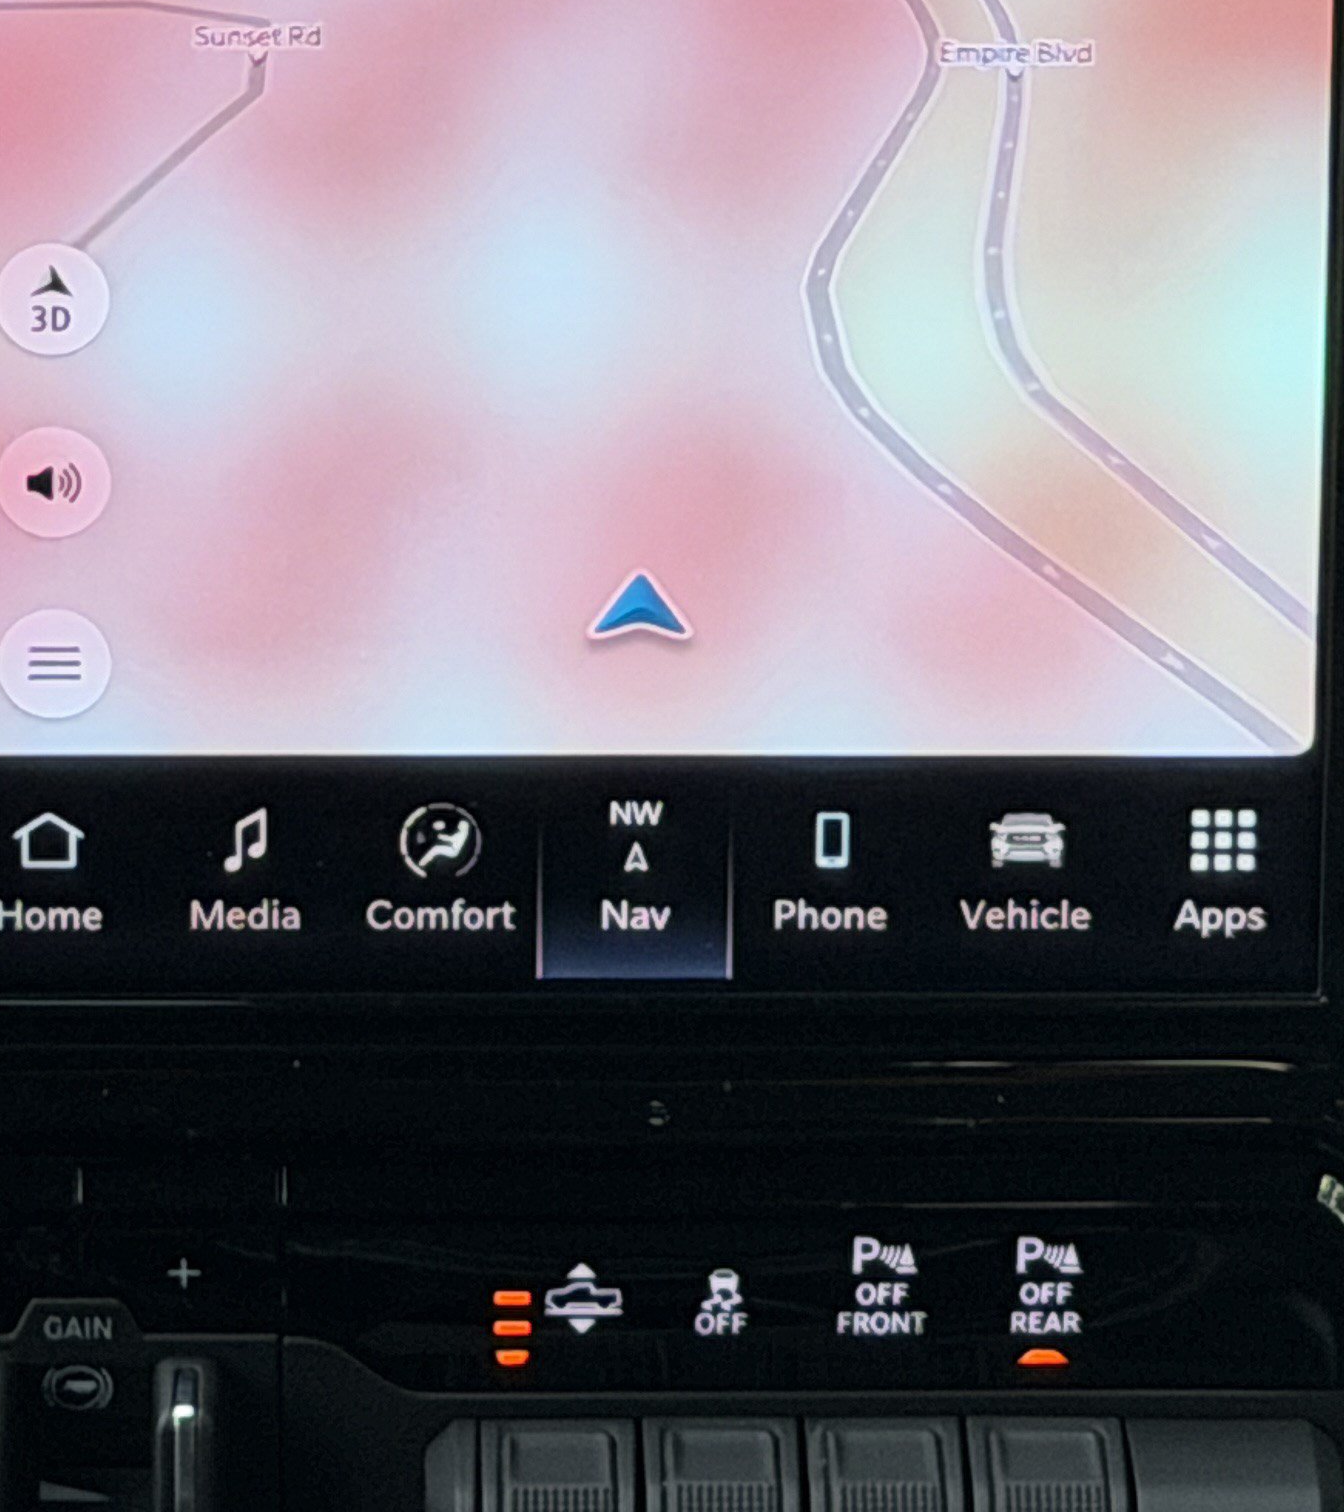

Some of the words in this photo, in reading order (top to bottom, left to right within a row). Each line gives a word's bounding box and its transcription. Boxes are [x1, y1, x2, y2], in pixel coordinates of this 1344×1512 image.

[195, 26, 281, 47] Sunset
[289, 26, 321, 47] Rd
[940, 42, 1029, 67] Empire
[1036, 42, 1092, 64] Blvd
[30, 307, 71, 333] 3D
[610, 802, 662, 825] NW
[190, 899, 301, 930] Media
[366, 898, 516, 930] Comfort
[601, 900, 670, 930] Nav
[774, 899, 887, 930] Phone
[960, 899, 1091, 930] Vehicle
[1174, 900, 1267, 938] Apps
[856, 1283, 908, 1305] OFF
[1020, 1283, 1072, 1305] OFF
[43, 1316, 113, 1340] GAIN
[695, 1313, 748, 1334] OFF
[837, 1312, 926, 1335] FRONT
[1011, 1312, 1081, 1335] REAR
